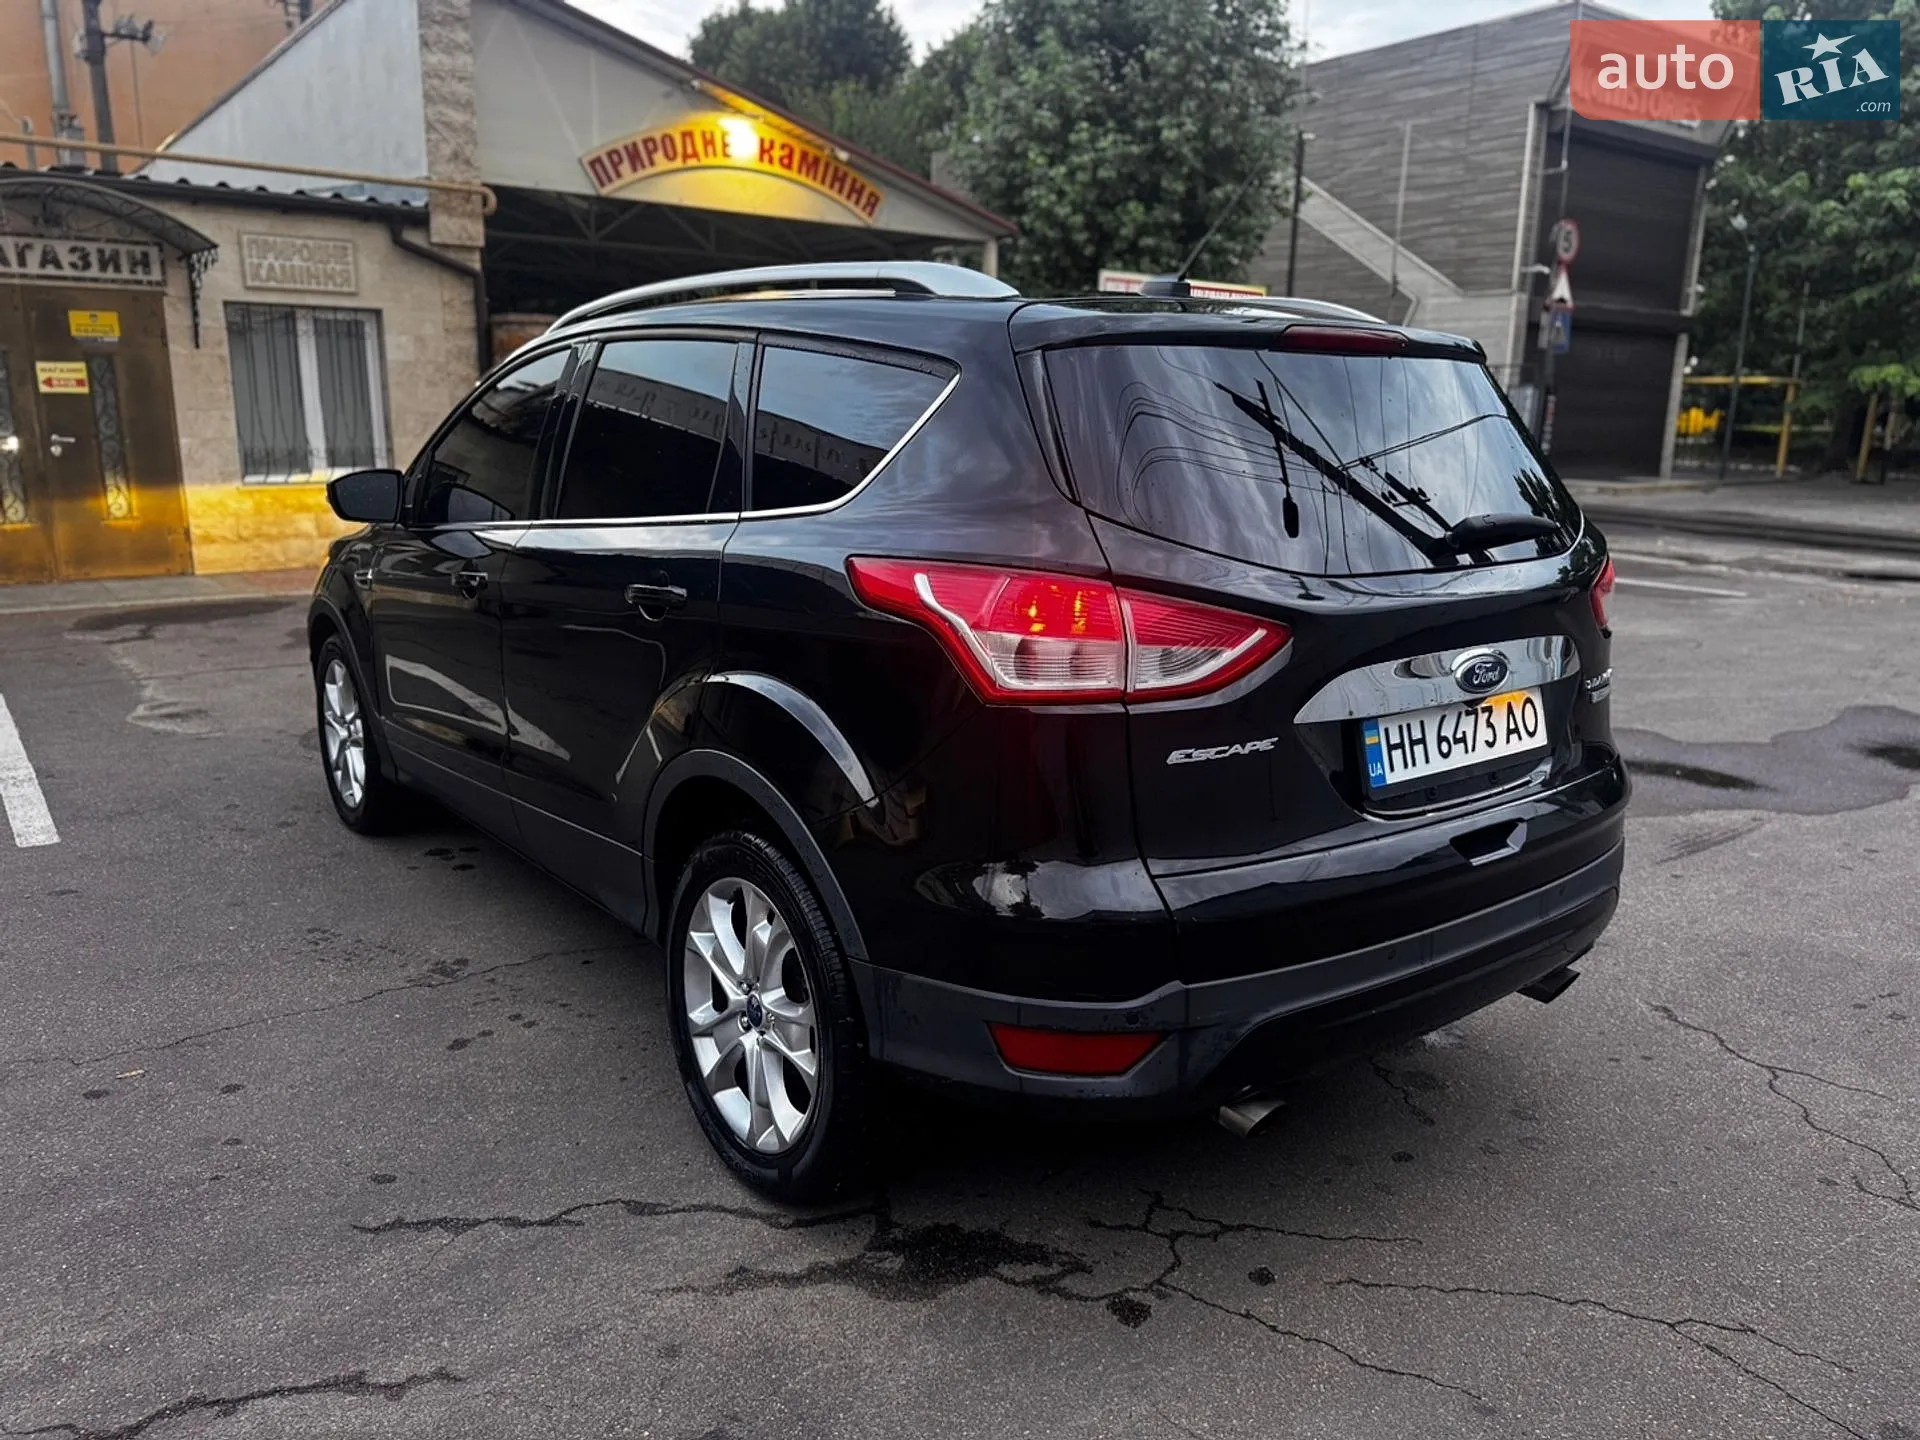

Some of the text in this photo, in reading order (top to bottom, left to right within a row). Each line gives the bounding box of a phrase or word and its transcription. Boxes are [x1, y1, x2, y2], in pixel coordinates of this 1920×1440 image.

[1473, 662, 1500, 684] Ford
[1437, 705, 1497, 760] 6473
[1166, 737, 1279, 765] ESCAPE
[1368, 762, 1384, 777] UA
